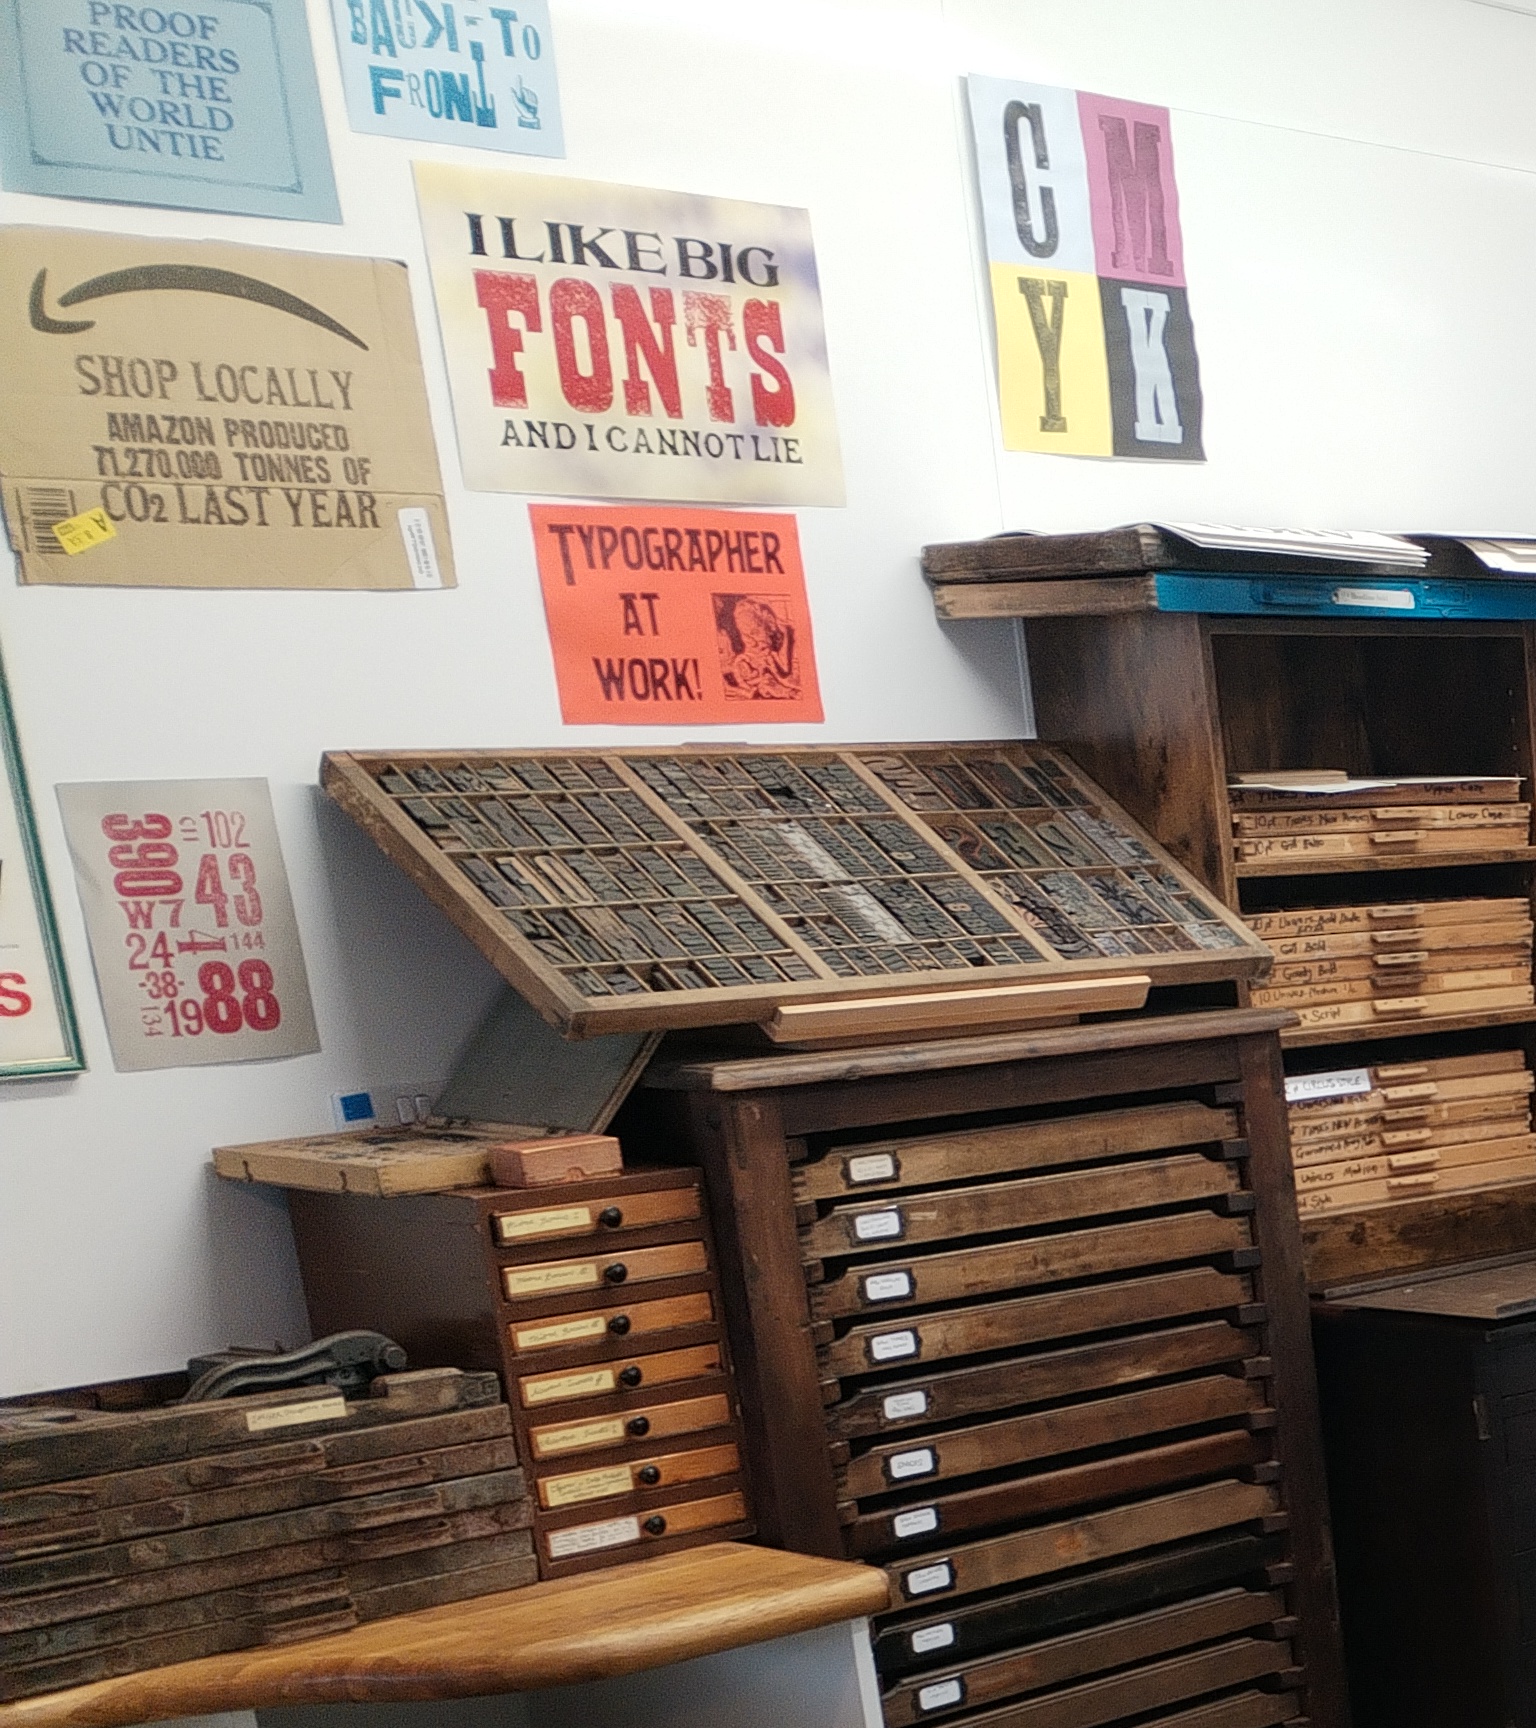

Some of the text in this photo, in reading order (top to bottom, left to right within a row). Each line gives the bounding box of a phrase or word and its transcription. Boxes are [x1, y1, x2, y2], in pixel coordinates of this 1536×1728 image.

[88, 1, 219, 40] PROOF
[63, 28, 240, 74] READERS
[79, 61, 232, 103] OF THE
[87, 90, 234, 132] WORLD
[105, 123, 225, 162] UNTIE
[464, 211, 779, 287] I LIKE BIG
[472, 268, 797, 427] FONTS
[75, 354, 353, 411] SHOP LOCALLY
[106, 412, 350, 451] AMAZON PRODUCED
[501, 420, 803, 464] AND I CANNOT LIE
[233, 451, 372, 486] TONNES OF
[176, 483, 271, 526] LAST
[285, 488, 381, 529] YEAR
[547, 523, 785, 586] TYPOGRAPHER
[619, 592, 660, 636] AT
[593, 657, 702, 701] WORK!
[200, 810, 250, 849] 102
[195, 852, 264, 928] 43
[125, 931, 175, 970] 24
[1312, 1006, 1342, 1025] Script
